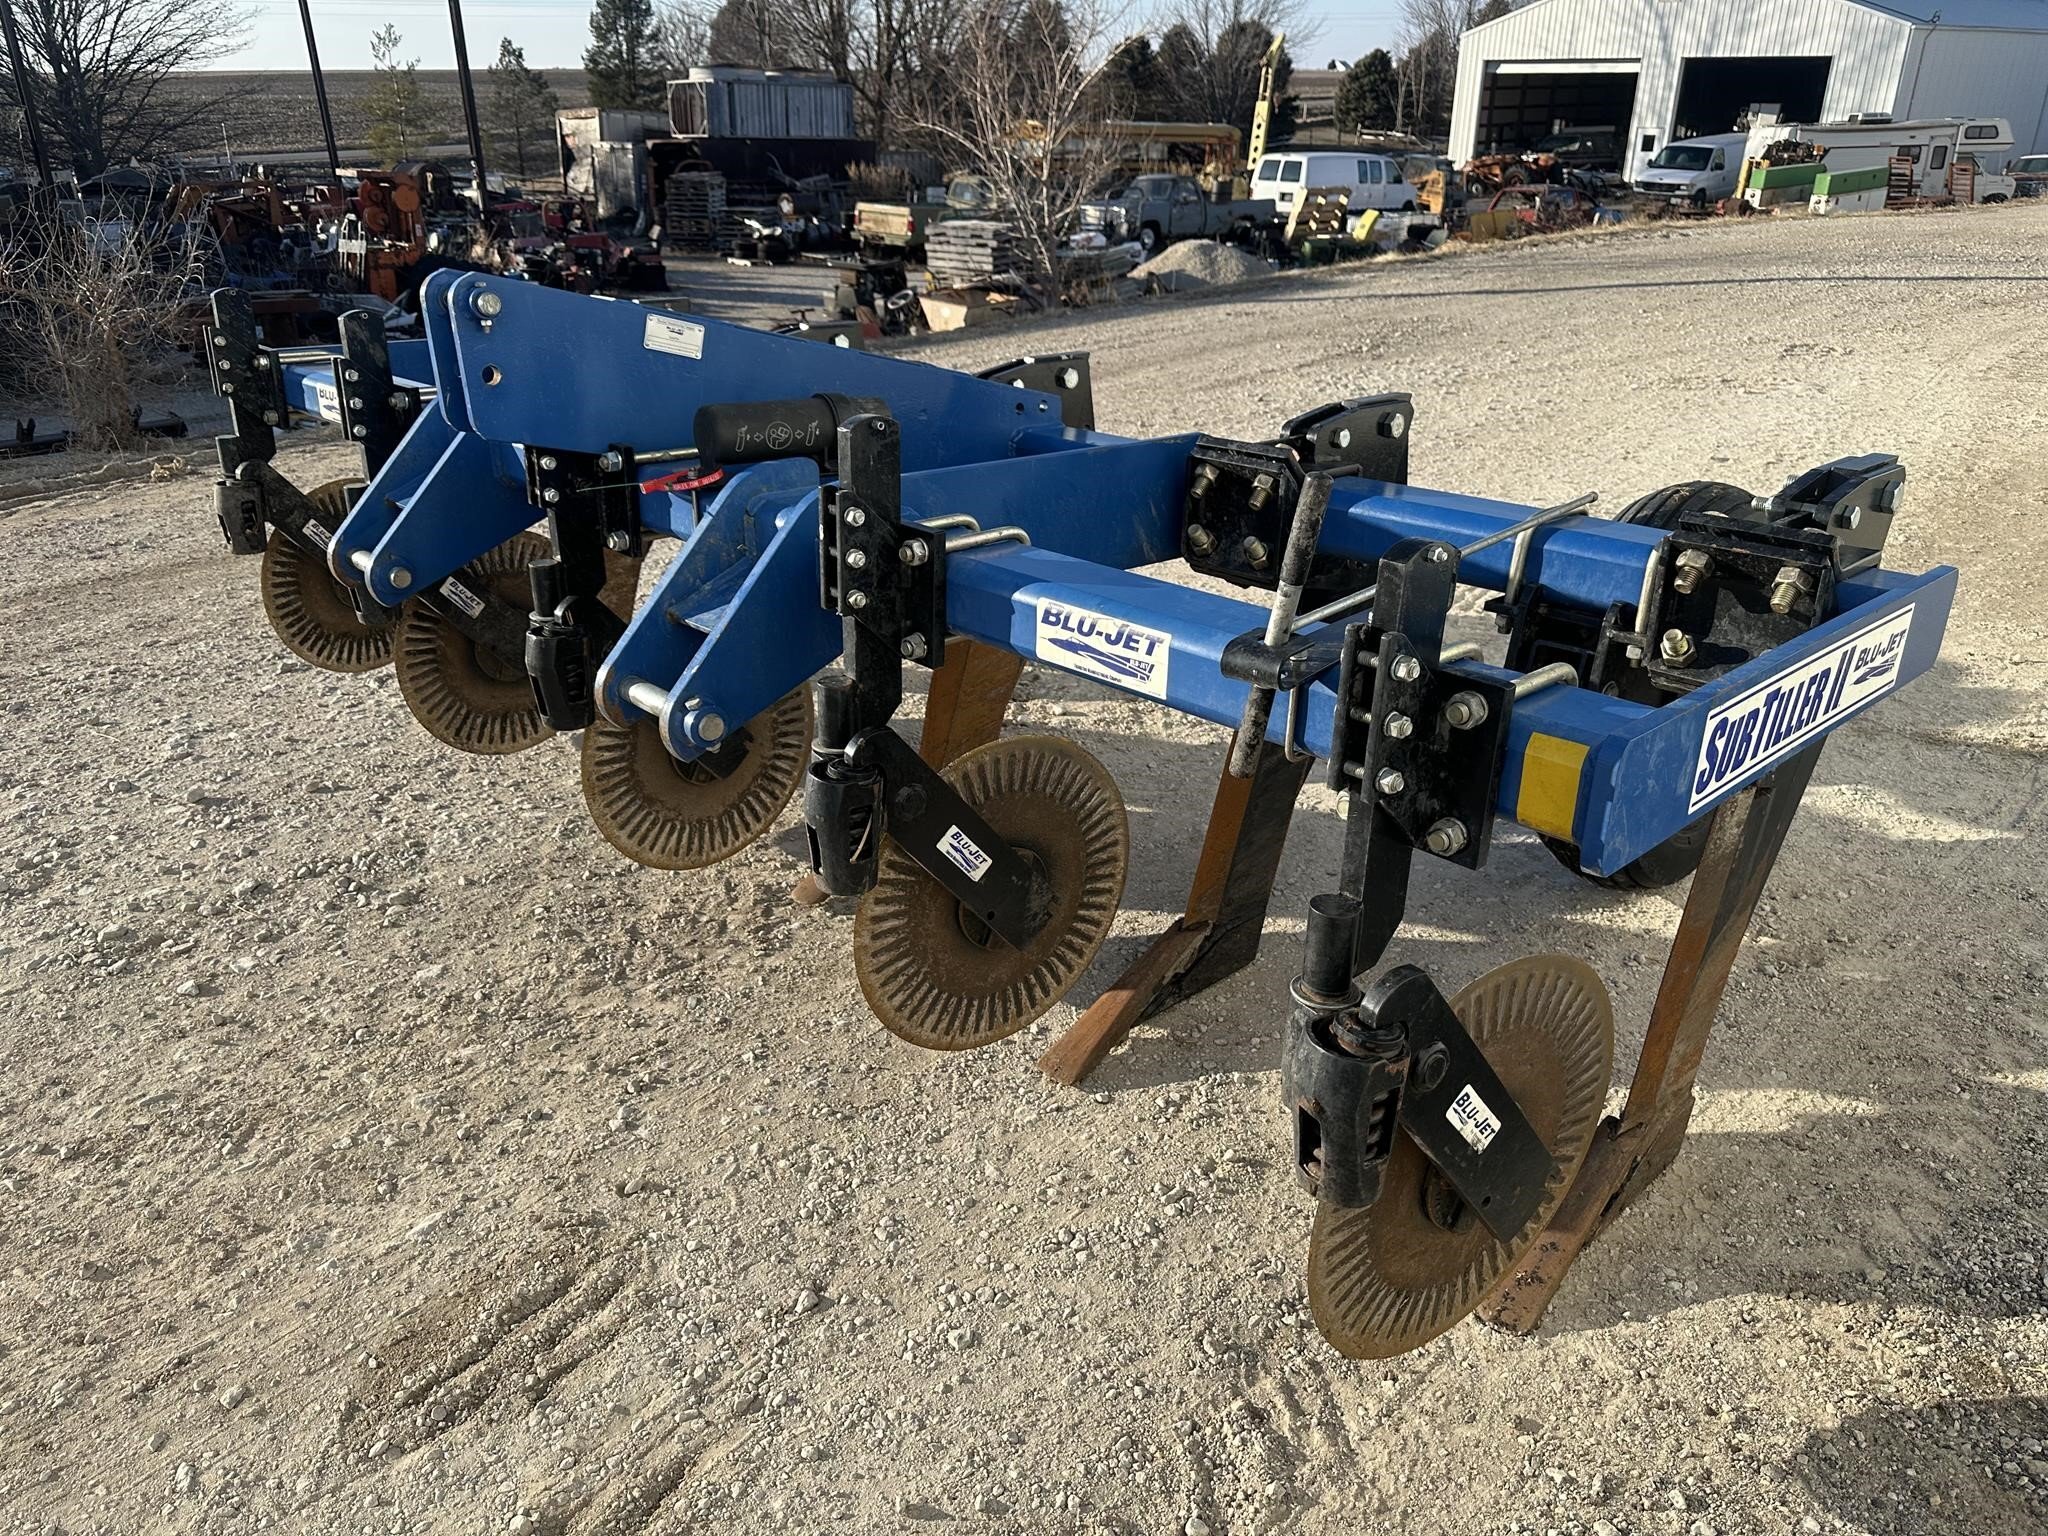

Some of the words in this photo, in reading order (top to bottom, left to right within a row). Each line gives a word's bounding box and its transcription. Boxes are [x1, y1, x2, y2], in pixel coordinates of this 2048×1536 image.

[319, 388, 338, 402] BLU-
[449, 581, 482, 606] BLU-JET
[1041, 602, 1165, 657] BLU-JET
[1853, 629, 1907, 672] BLU-JET
[1823, 644, 1857, 717] II
[950, 831, 988, 865] BLU-JET
[1455, 1092, 1496, 1140] BLU-JET
